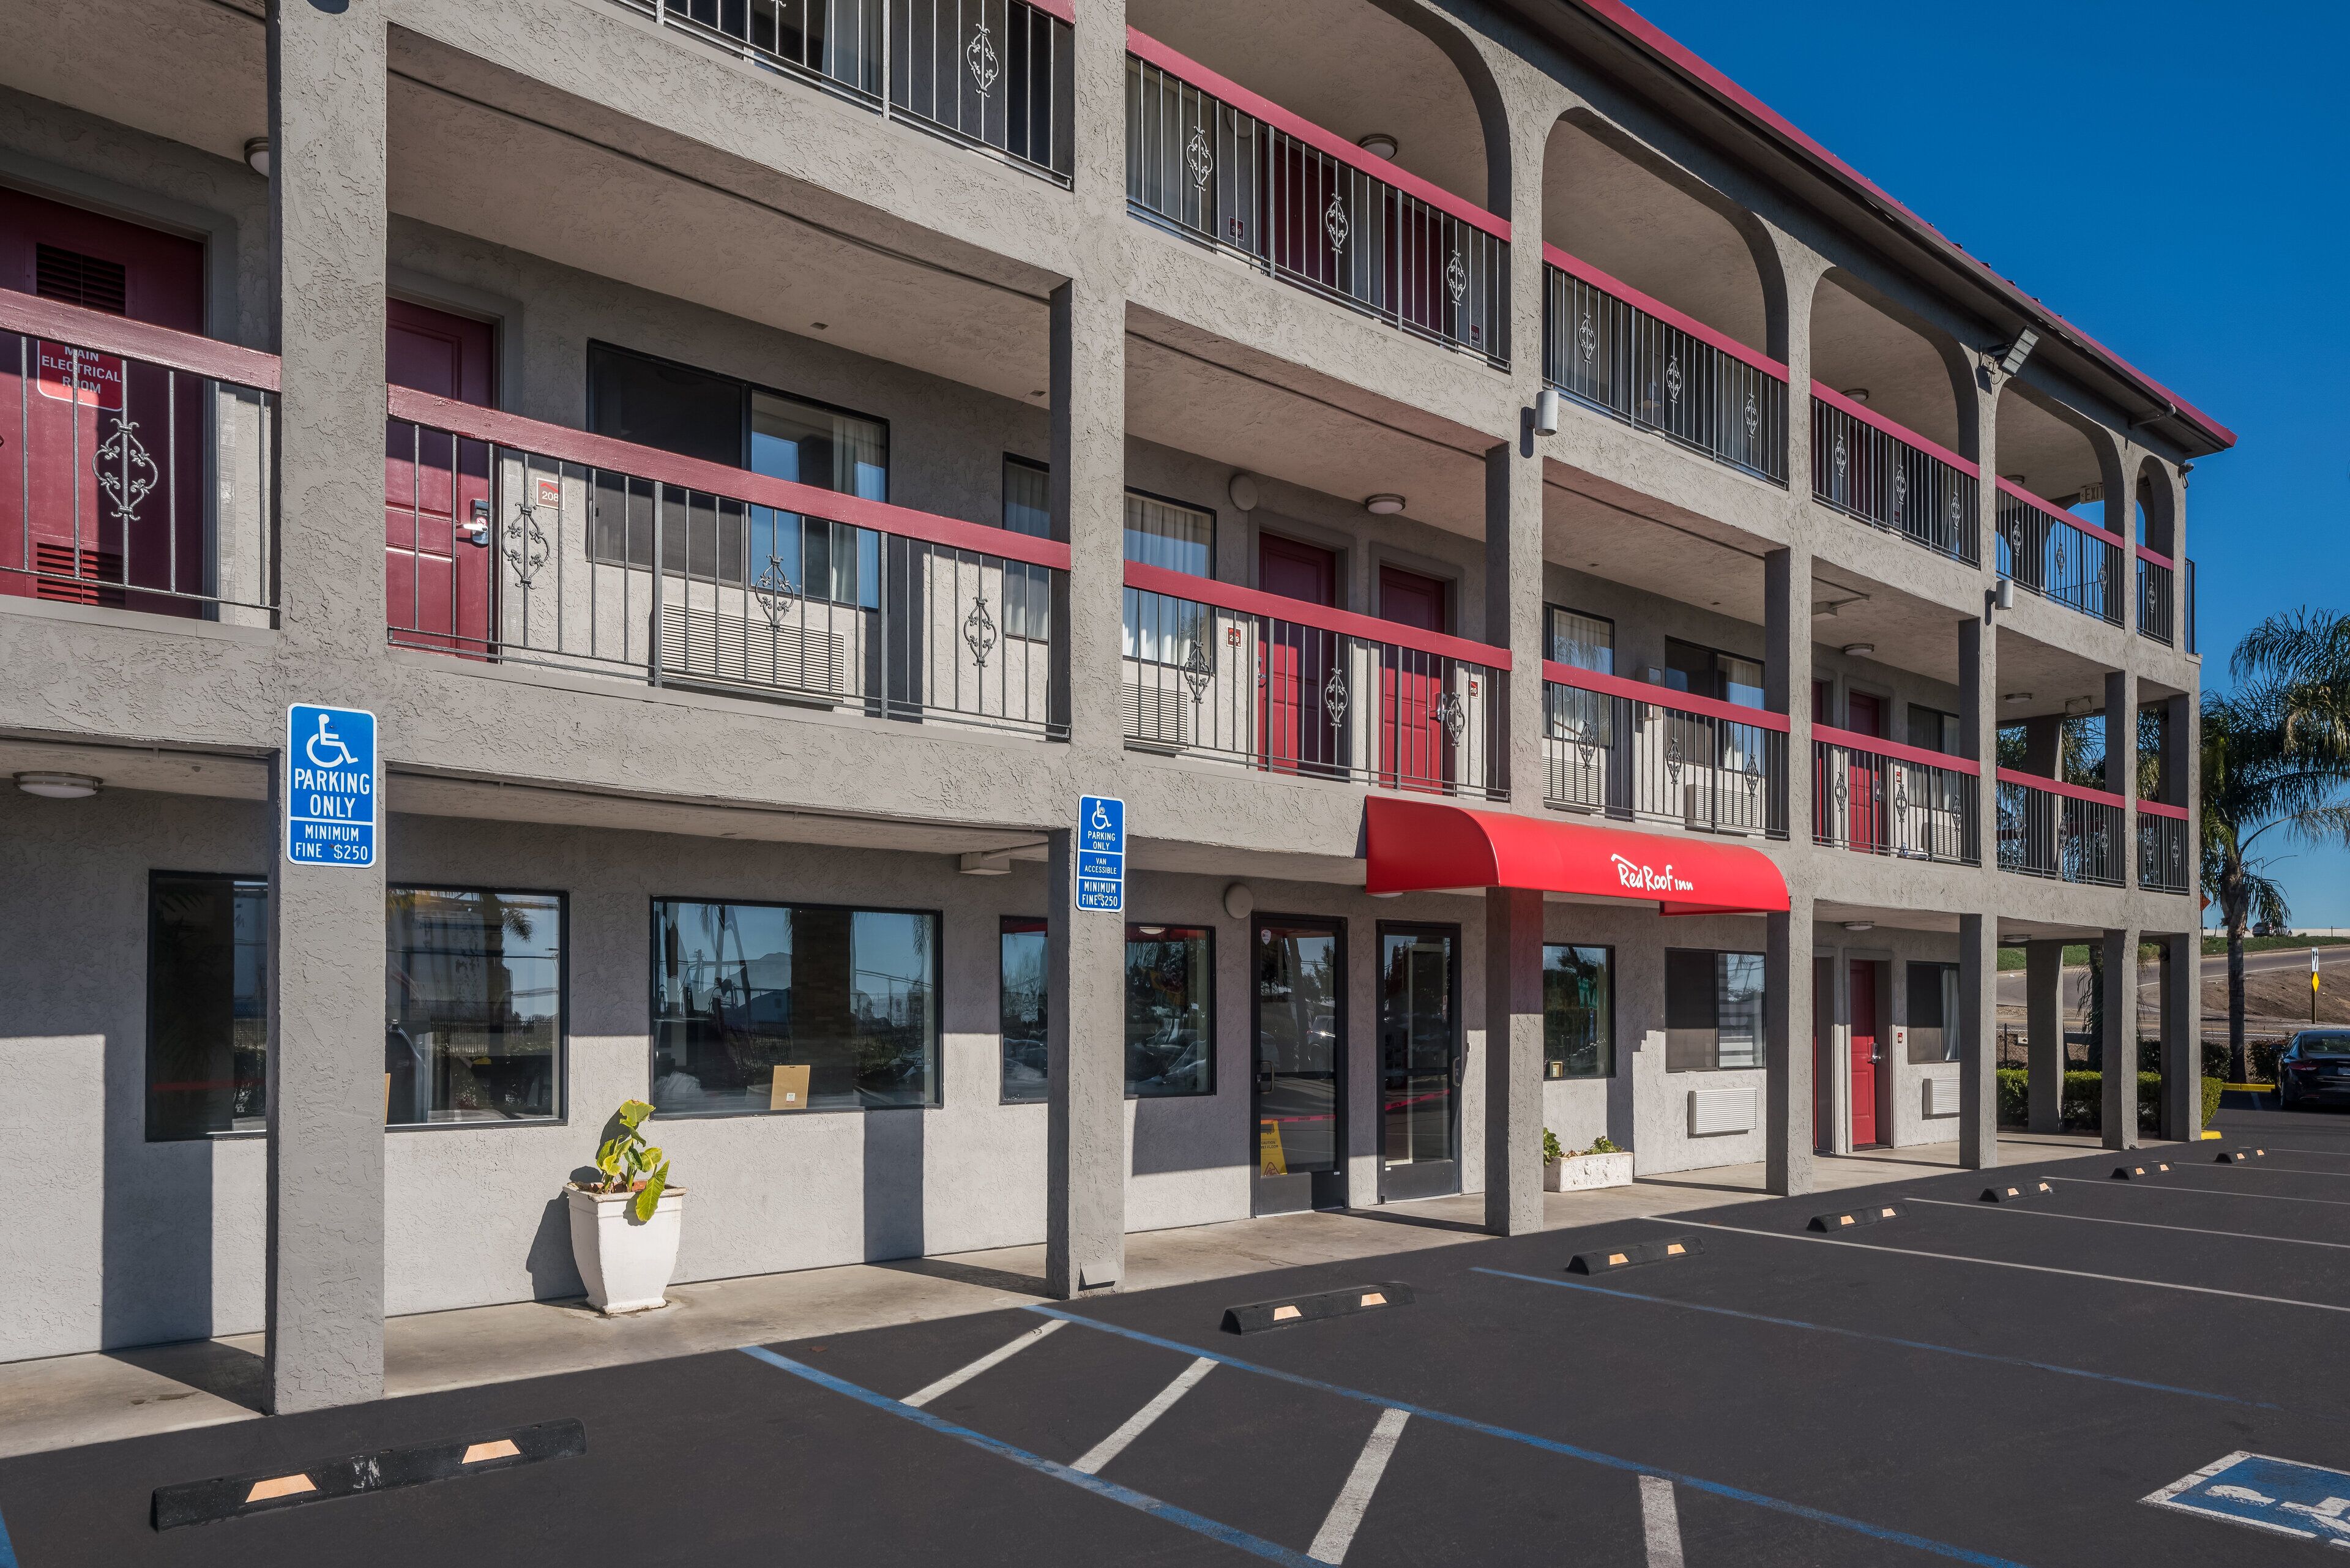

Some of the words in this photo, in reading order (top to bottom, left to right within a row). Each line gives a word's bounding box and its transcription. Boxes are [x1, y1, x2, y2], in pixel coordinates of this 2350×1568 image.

[1231, 226, 1242, 235] 39
[65, 346, 99, 362] MAIN
[42, 355, 121, 383] ELECTRICAL
[542, 491, 558, 502] 208
[1229, 635, 1239, 643] 29
[294, 768, 370, 794] PARKING
[310, 794, 356, 818] ONLY
[305, 824, 359, 842] MINIMUM
[1087, 831, 1116, 842] PARKING
[296, 842, 323, 858] FINE
[334, 843, 368, 861] $250
[1093, 841, 1110, 851] ONLY
[1084, 865, 1117, 875] ACCESSIBLE
[1084, 881, 1116, 894] MINIMUM
[1082, 894, 1099, 905] FINE
[1100, 895, 1118, 907] $250
